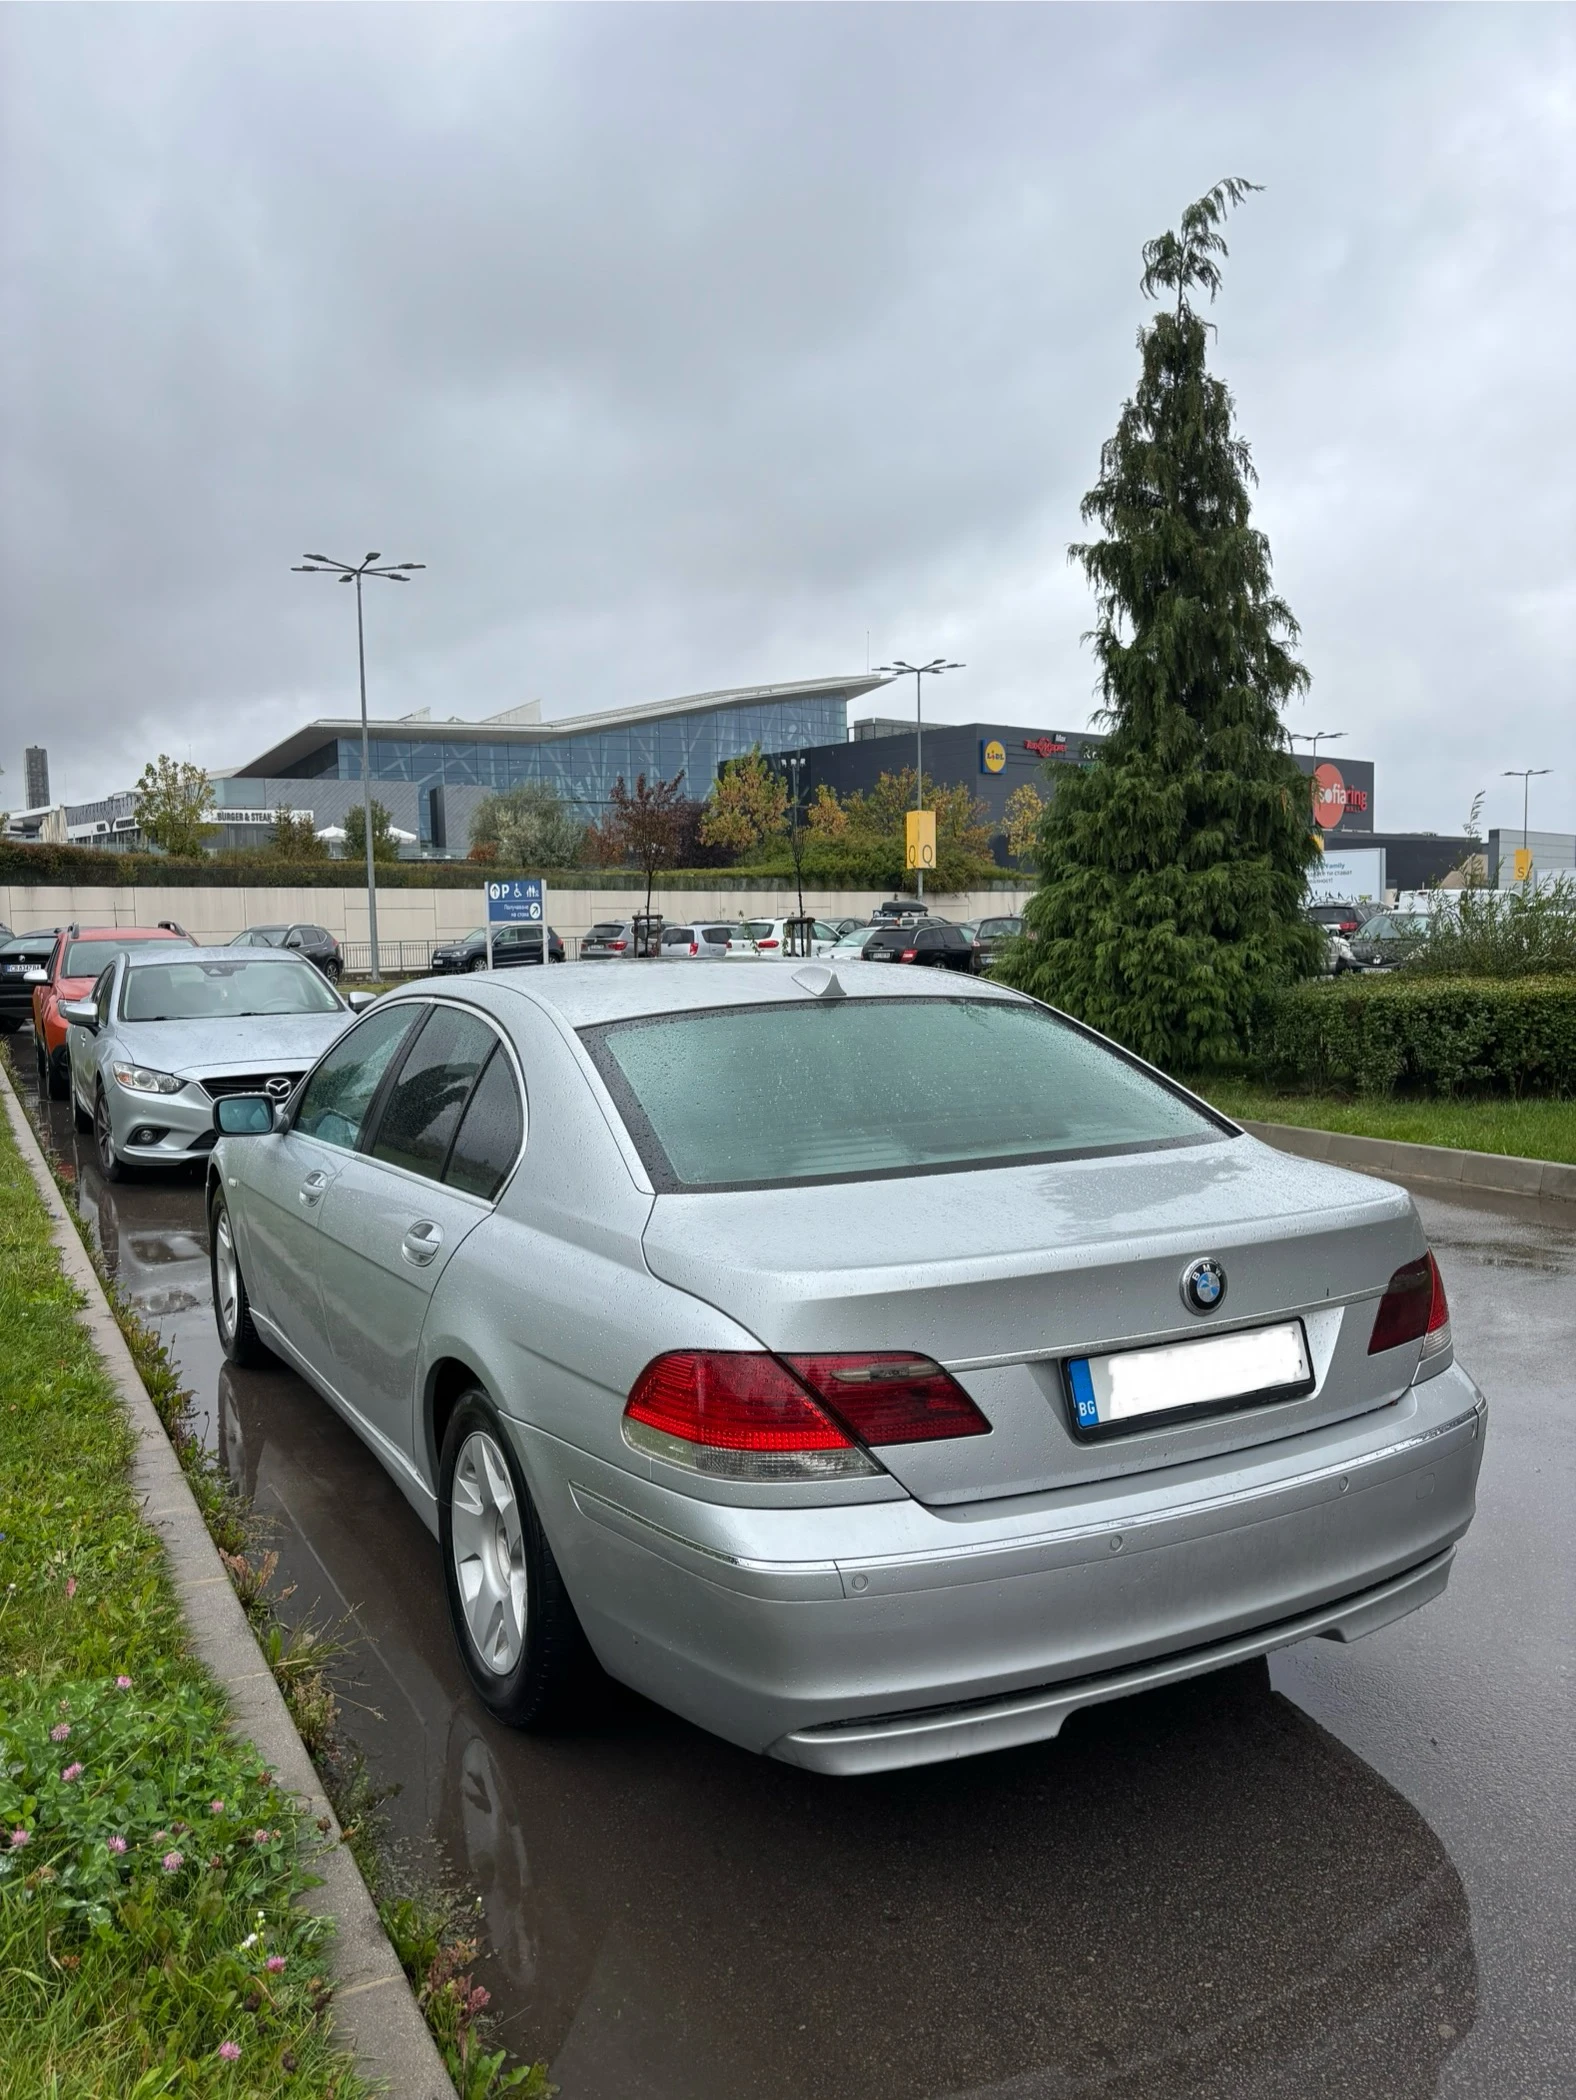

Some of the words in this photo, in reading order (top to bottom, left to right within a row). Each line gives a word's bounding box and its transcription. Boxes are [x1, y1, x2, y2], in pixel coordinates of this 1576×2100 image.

[217, 812, 243, 822] BURGER
[244, 812, 250, 822] &
[908, 844, 916, 868] Q
[922, 844, 933, 868] Q
[1517, 866, 1525, 878] S
[501, 884, 510, 899] P
[1191, 1264, 1223, 1281] BMW
[1078, 1401, 1096, 1417] BG
